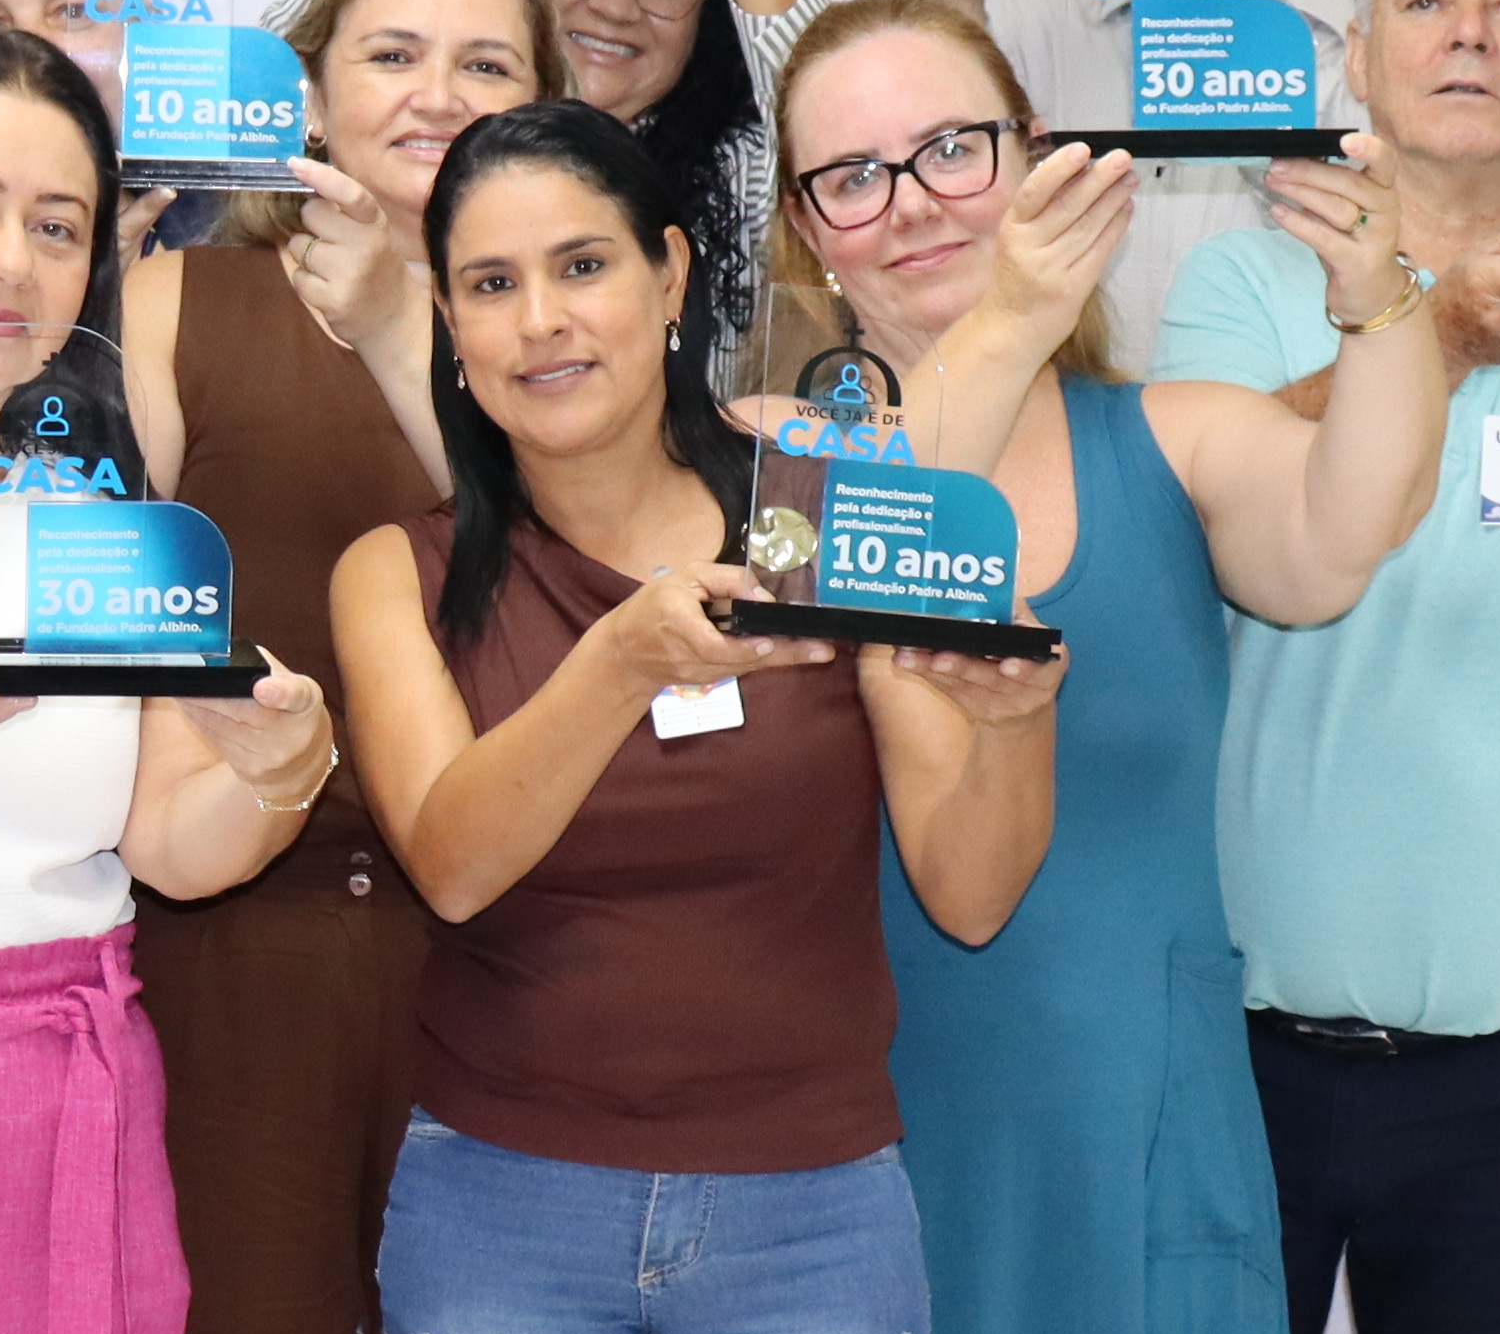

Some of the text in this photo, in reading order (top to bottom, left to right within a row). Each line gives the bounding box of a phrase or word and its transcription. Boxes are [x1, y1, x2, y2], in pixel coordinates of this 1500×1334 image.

[1140, 62, 1307, 98] 30 anos
[133, 89, 295, 129] 10 anos
[777, 418, 916, 466] CASA
[831, 534, 1006, 586] 10 anos
[36, 578, 220, 616] 30 anos
